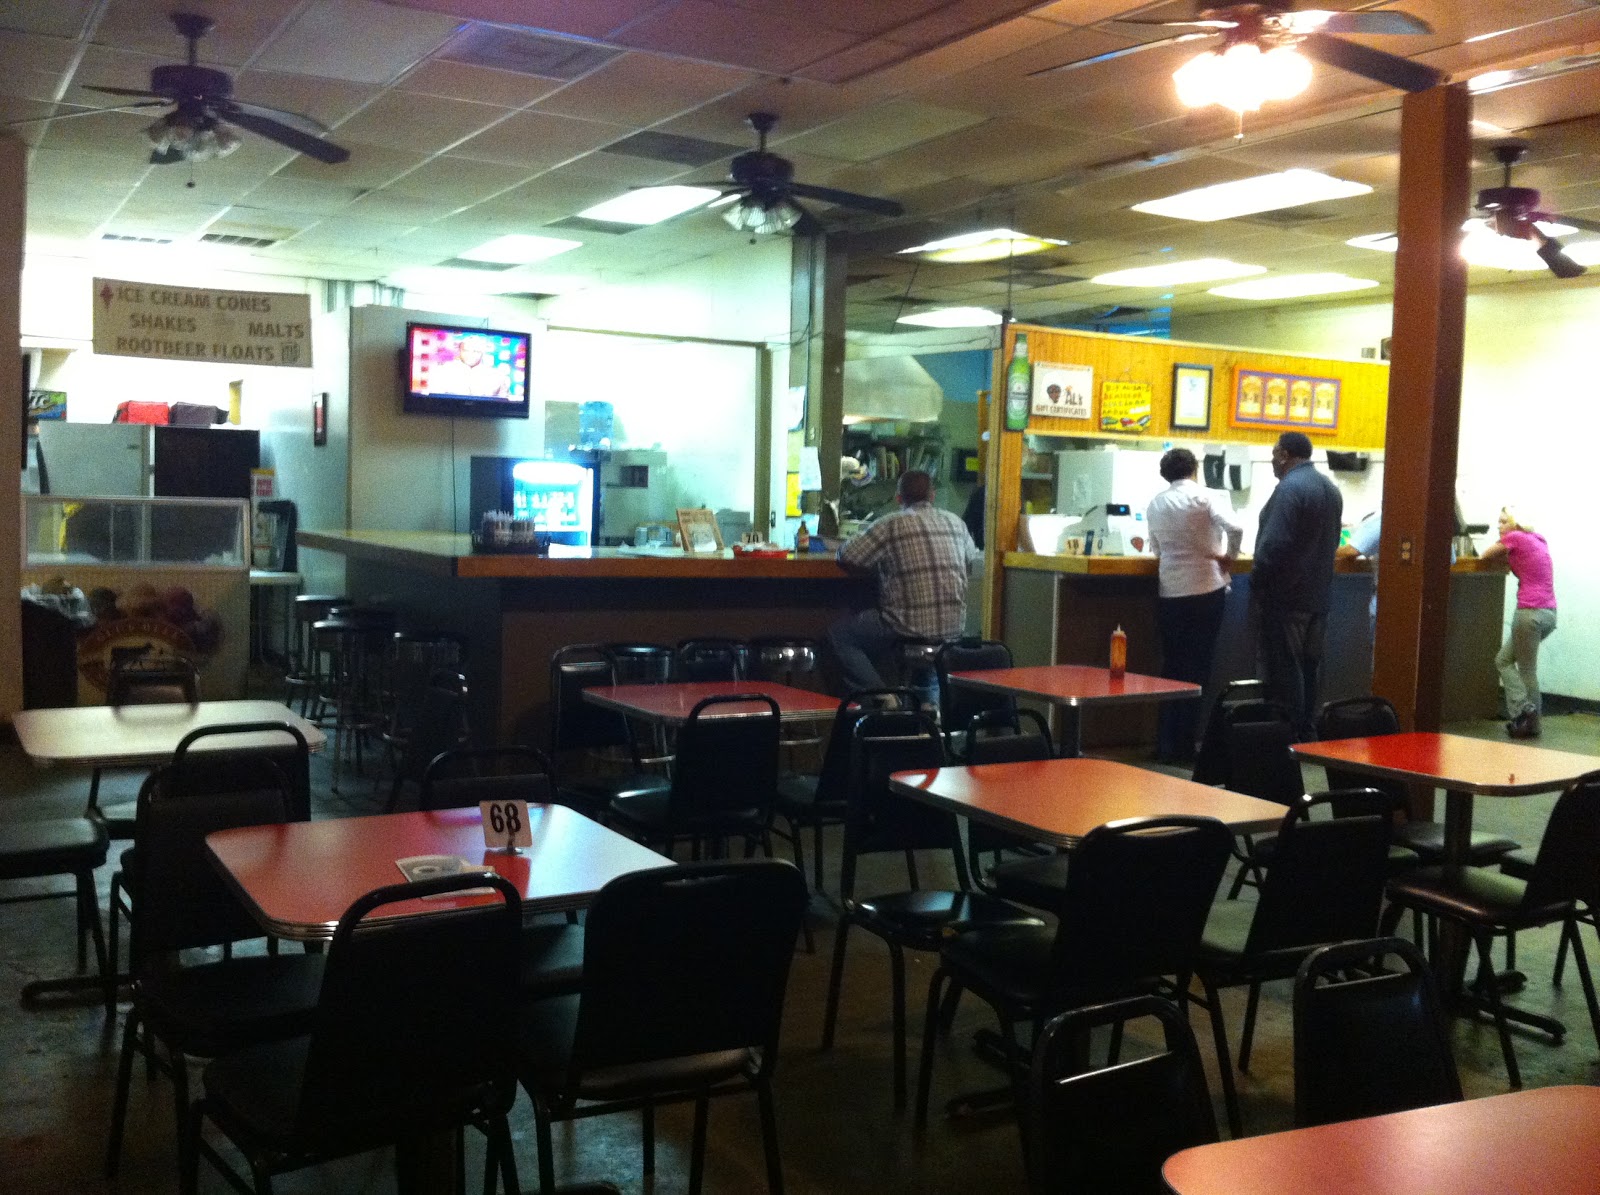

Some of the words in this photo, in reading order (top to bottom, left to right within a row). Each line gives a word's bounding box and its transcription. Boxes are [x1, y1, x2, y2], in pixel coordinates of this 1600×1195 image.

[118, 286, 143, 304] ICE
[150, 289, 211, 309] CREAM
[216, 296, 272, 313] CONES
[129, 312, 198, 334] SHAKES
[248, 322, 305, 340] MALTS
[116, 336, 206, 358] ROOTBEER
[212, 343, 275, 362] FLOATS
[490, 803, 521, 833] 68
